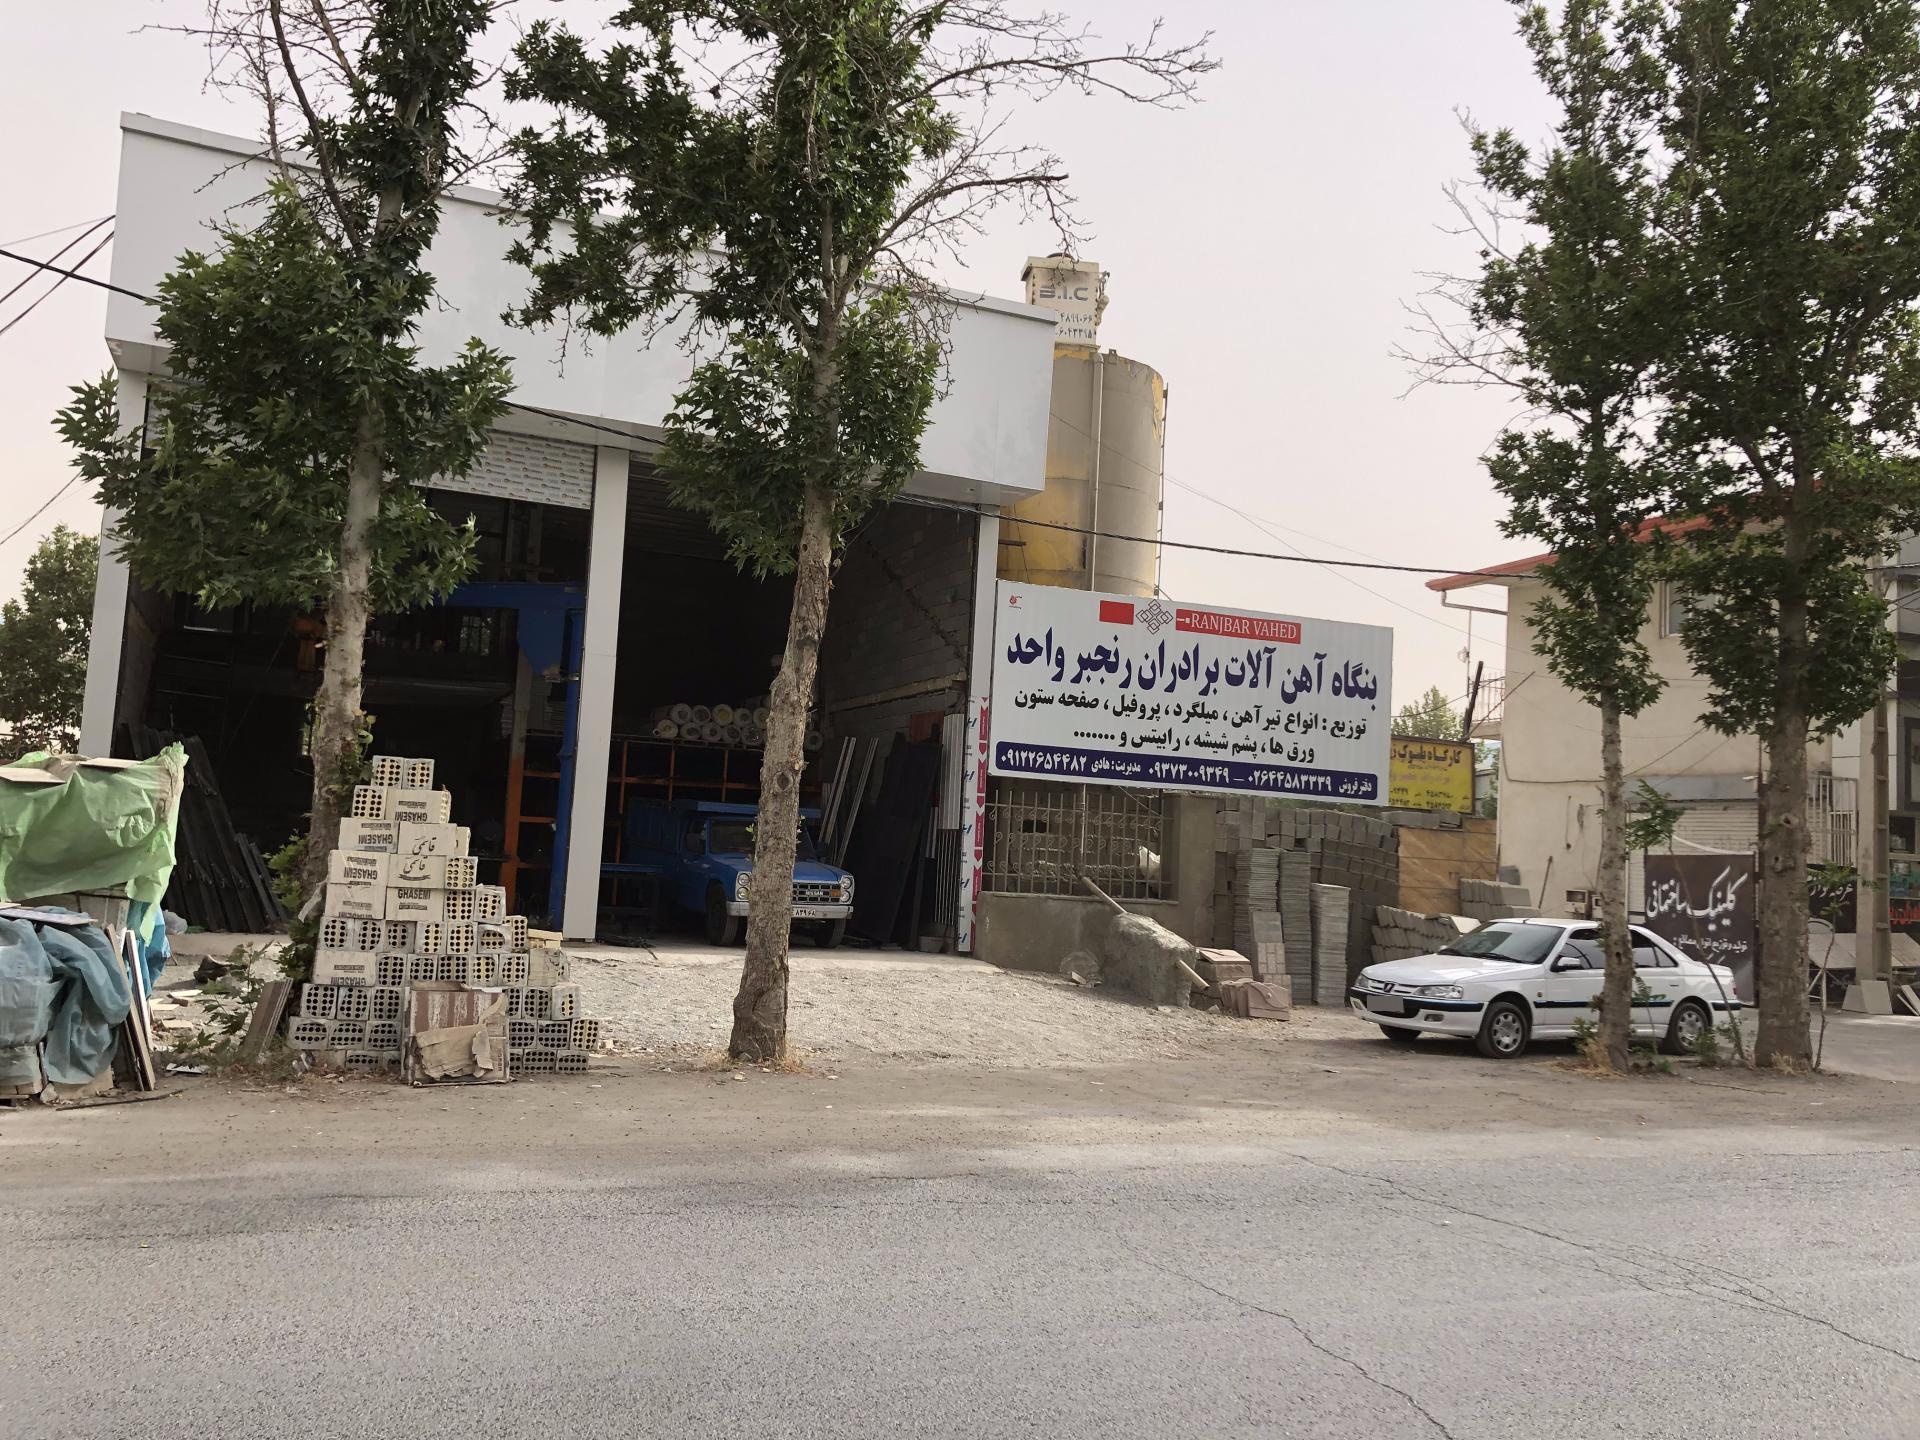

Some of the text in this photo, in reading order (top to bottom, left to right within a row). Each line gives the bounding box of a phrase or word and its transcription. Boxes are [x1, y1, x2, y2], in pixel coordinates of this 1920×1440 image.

[1191, 613, 1297, 639] RANJBAR VAHED
[1007, 626, 1377, 711] بنگاه آهن آلات برادران رنجبر واحد
[1015, 689, 1054, 709] ستون
[1058, 690, 1099, 709] صفحه
[1112, 693, 1160, 721] پروفیل
[1173, 701, 1218, 723] میلگرد
[1284, 711, 1318, 735] انواع
[1131, 727, 1181, 751] رابیتس
[1330, 718, 1367, 740] توزیع
[1193, 731, 1228, 754] شیشه
[1231, 735, 1257, 759] پشم
[1287, 741, 1315, 763] ورق
[1001, 748, 1087, 772] ۰۹۱۲۲۶۵۴۴۸۲
[1148, 761, 1230, 784] ۰۹۳۷۳۰۰۹۳۴۹
[1248, 769, 1332, 792] ۰۲۶۴۴۵۸۳۳۳۹
[395, 811, 428, 822] GHASEMI
[358, 834, 394, 845] GHASEMI
[344, 866, 378, 880] GHASEMI
[397, 888, 432, 900] GHASEMI
